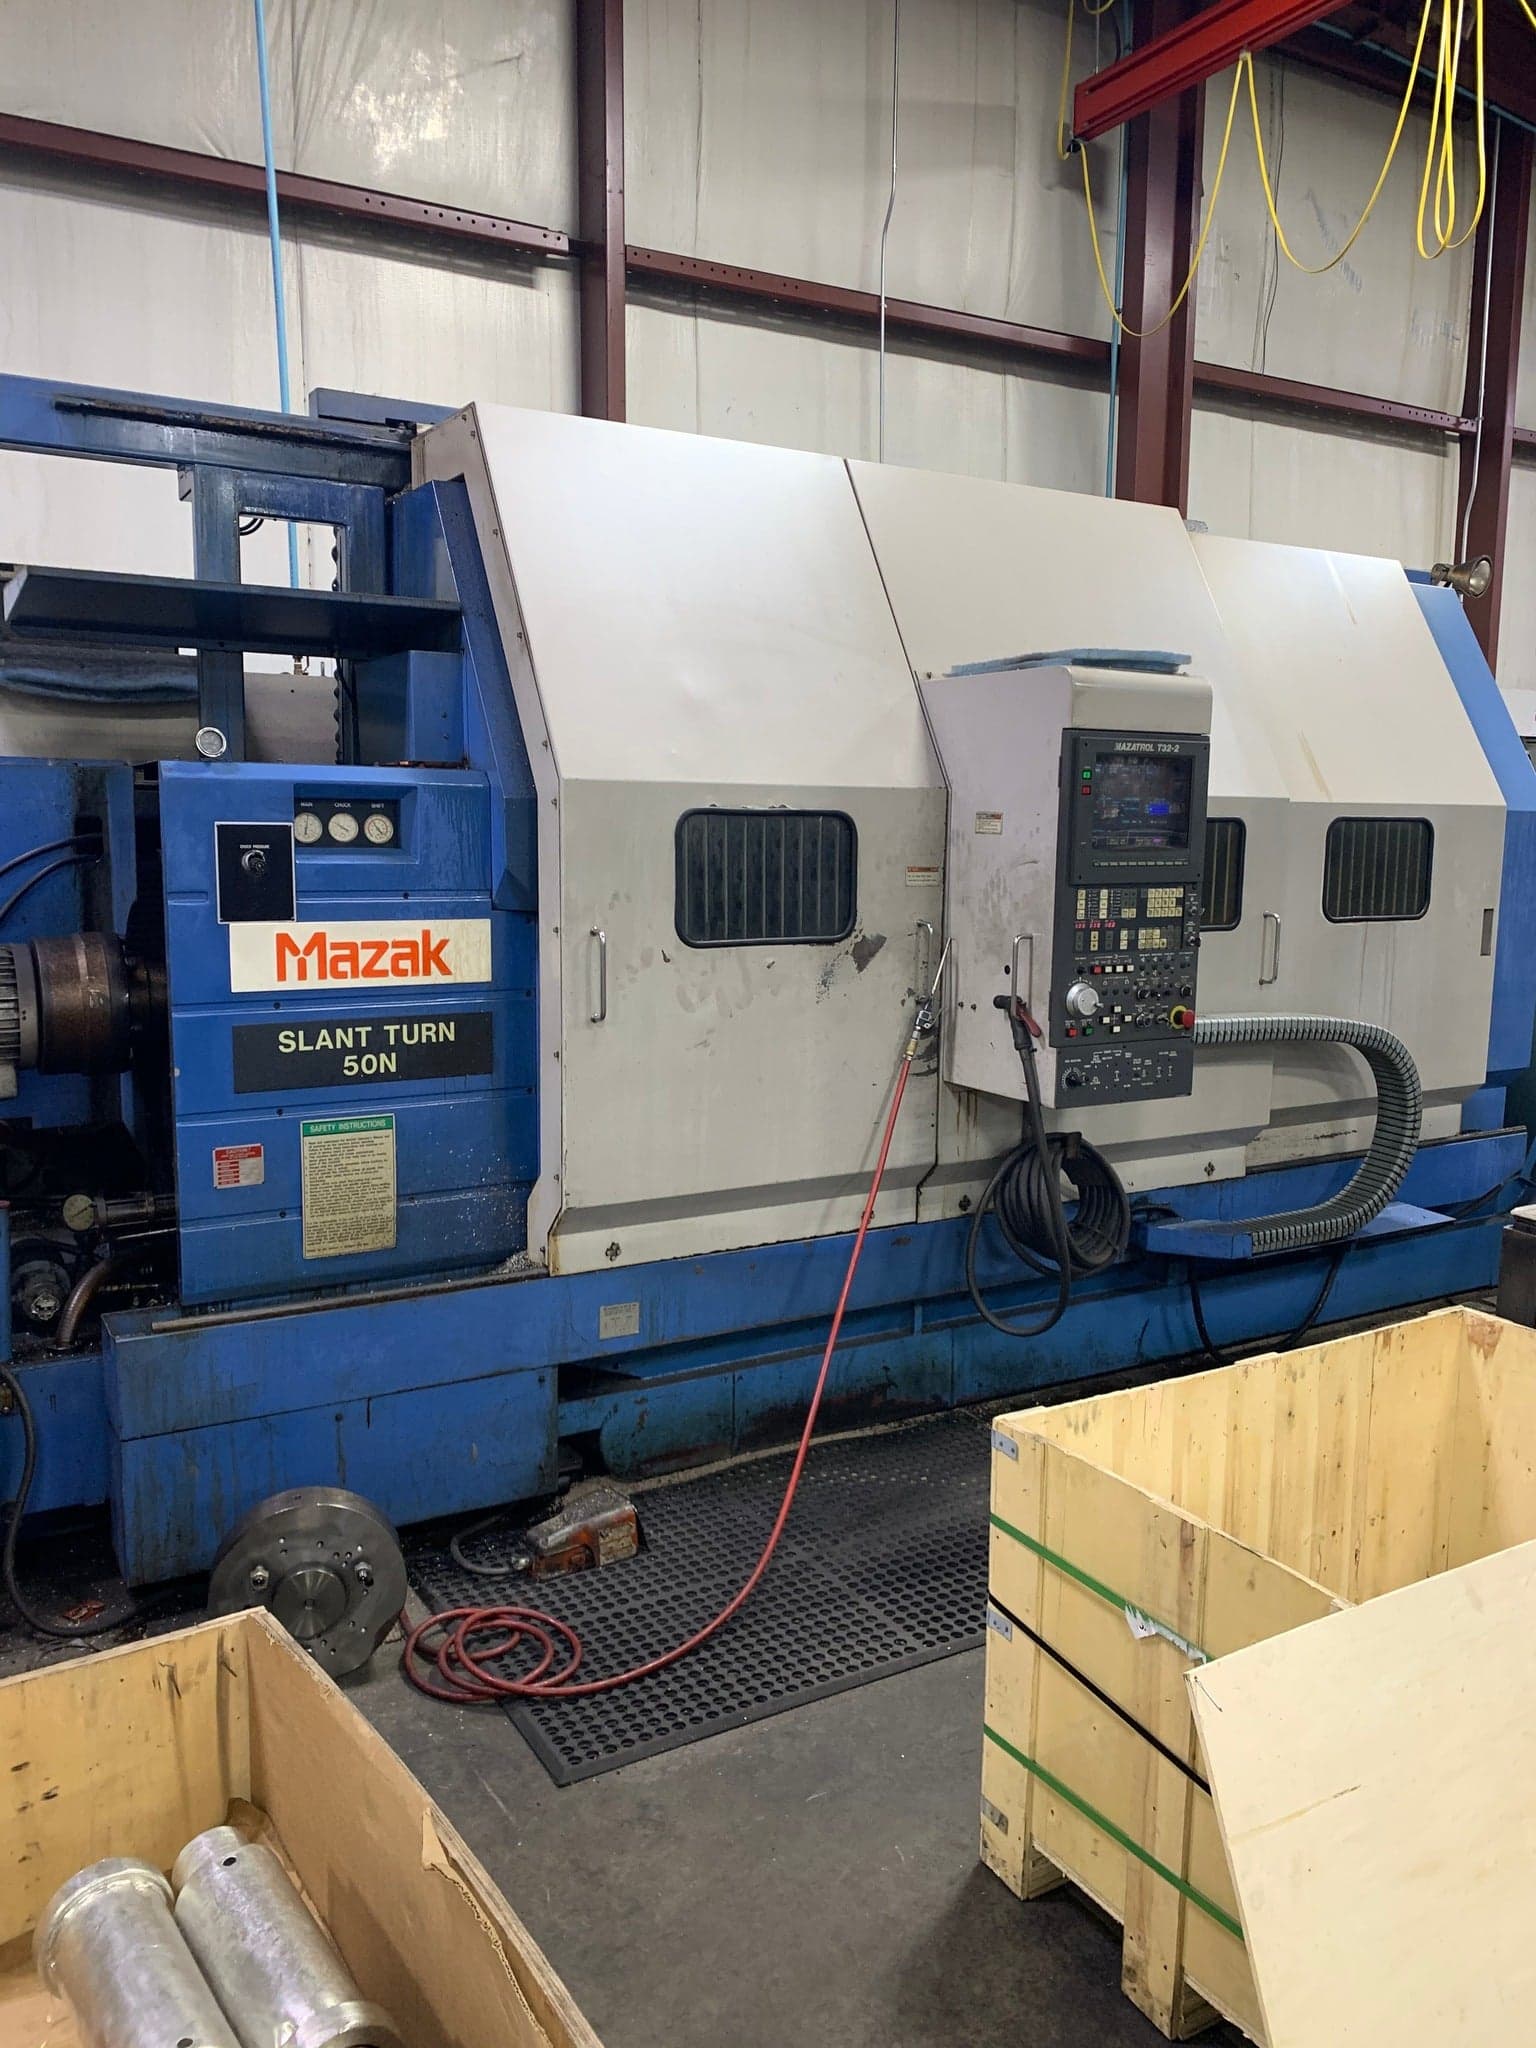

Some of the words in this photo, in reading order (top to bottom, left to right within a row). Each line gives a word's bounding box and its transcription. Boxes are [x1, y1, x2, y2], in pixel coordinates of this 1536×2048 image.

[1114, 742, 1155, 752] MAZATROL
[275, 929, 453, 982] Mazak
[278, 1026, 372, 1053] SLANT
[384, 1021, 456, 1046] TURN
[343, 1052, 397, 1076] 50N
[310, 1123, 336, 1133] SAFETY
[339, 1119, 386, 1130] INSTRUCTIONS
